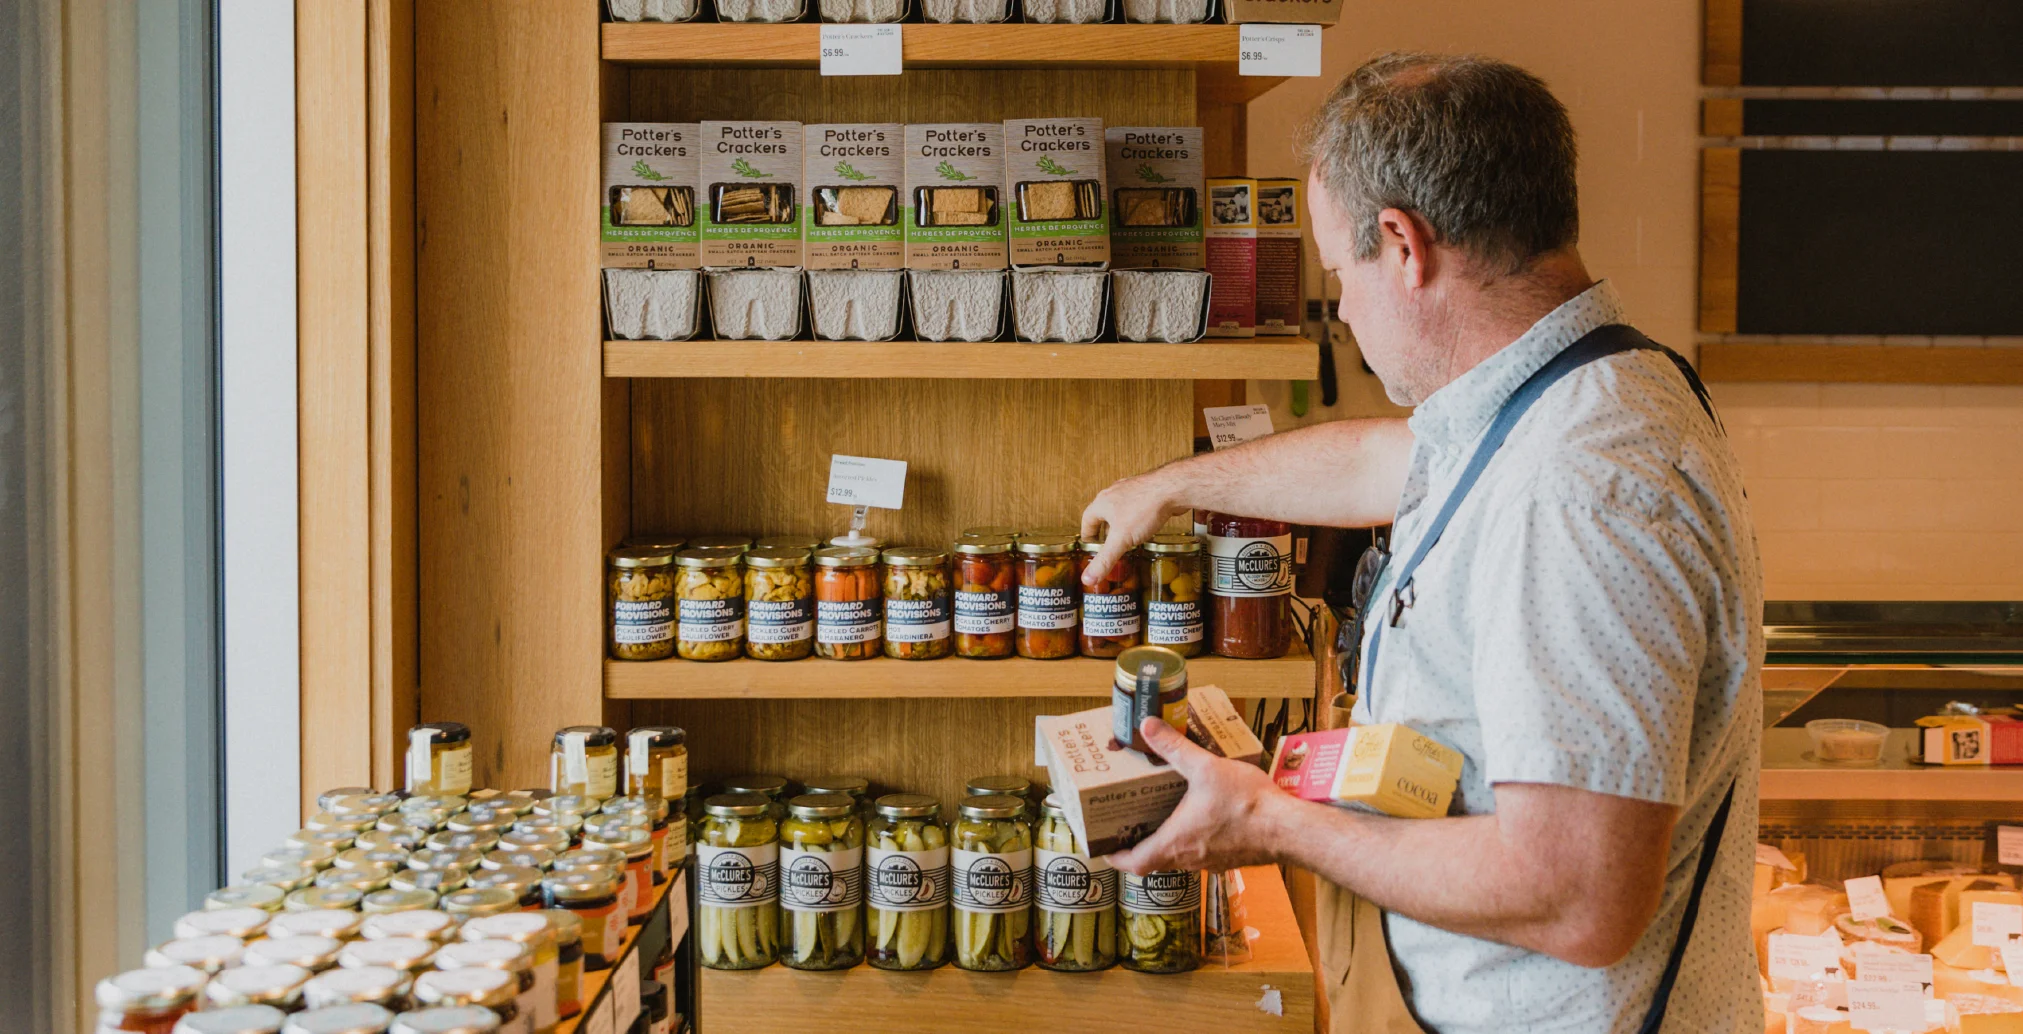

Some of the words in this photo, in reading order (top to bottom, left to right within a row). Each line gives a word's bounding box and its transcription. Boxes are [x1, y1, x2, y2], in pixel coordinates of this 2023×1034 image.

[823, 48, 844, 57] $6.99
[1242, 52, 1262, 61] $6.99
[622, 128, 682, 142] Potter's
[721, 126, 782, 139] Potter's
[825, 128, 885, 142] Potter's
[925, 129, 986, 142] Potter's
[1025, 124, 1085, 137] Potter's
[1125, 132, 1184, 145] Potter's
[617, 143, 687, 157] Crackers
[717, 142, 787, 155] Crackers
[820, 144, 890, 157] Crackers
[921, 144, 991, 157] Crackers
[1021, 139, 1091, 152] Crackers
[1121, 148, 1189, 160] Crackers
[1036, 239, 1083, 247] ORGANIC
[830, 487, 853, 498] $12.99
[955, 591, 998, 601] FORWARD
[1019, 587, 1063, 597] FORWARD
[680, 599, 725, 609] FORWARD
[1019, 595, 1071, 606] PROVISIONS
[1084, 595, 1130, 604] FORWARD
[615, 601, 662, 611] FORWARD
[749, 600, 795, 610] FORWARD
[818, 601, 863, 611] FORWARD
[887, 600, 932, 610] FORWARD
[955, 600, 1006, 611] PROVISIONS
[1084, 602, 1136, 613] PROVISIONS
[1150, 602, 1195, 612] FORWARD
[616, 608, 670, 619] PROVISIONS
[681, 607, 734, 618] PROVISIONS
[750, 608, 803, 619] PROVISIONS
[818, 609, 871, 619] PROVISIONS
[887, 608, 941, 618] PROVISIONS
[1020, 612, 1047, 620] PICKLED
[1049, 611, 1074, 620] CHERRY
[1150, 610, 1201, 621] PROVISIONS
[956, 617, 982, 625] PICKLED
[984, 617, 1010, 625] CHERRY
[1020, 619, 1055, 627] TOMATOES
[1085, 619, 1115, 628] PICKLED
[616, 626, 647, 634] PICKLED
[650, 624, 671, 633] CURRY
[681, 625, 709, 634] PICKLED
[712, 624, 734, 633] CURRY
[751, 625, 778, 634] PICKLED
[780, 624, 804, 633] CURRY
[819, 626, 847, 634] PICKLED
[850, 624, 879, 633] CARROTS
[956, 624, 990, 632] TOMATOES
[1086, 626, 1123, 634] TOMATOES
[1150, 627, 1180, 635] PICKLED
[616, 632, 667, 641] CAULIFLOWER
[681, 632, 730, 640] CAULIFLOWER
[751, 632, 799, 641] CAULIFLOWER
[824, 633, 864, 641] HABANERO
[888, 632, 934, 640] GIARDINIERA
[1151, 634, 1188, 642] TOMATOES
[1057, 729, 1091, 773] Potter's
[1074, 722, 1110, 772] Crackers
[1397, 777, 1438, 806] cocoa
[1089, 789, 1137, 806] Potter's
[716, 884, 745, 893] PICKLES
[885, 889, 913, 897] PICKLES
[796, 890, 824, 898] PICKLES
[975, 890, 1004, 898] PICKLES
[1052, 890, 1081, 899] PICKLES
